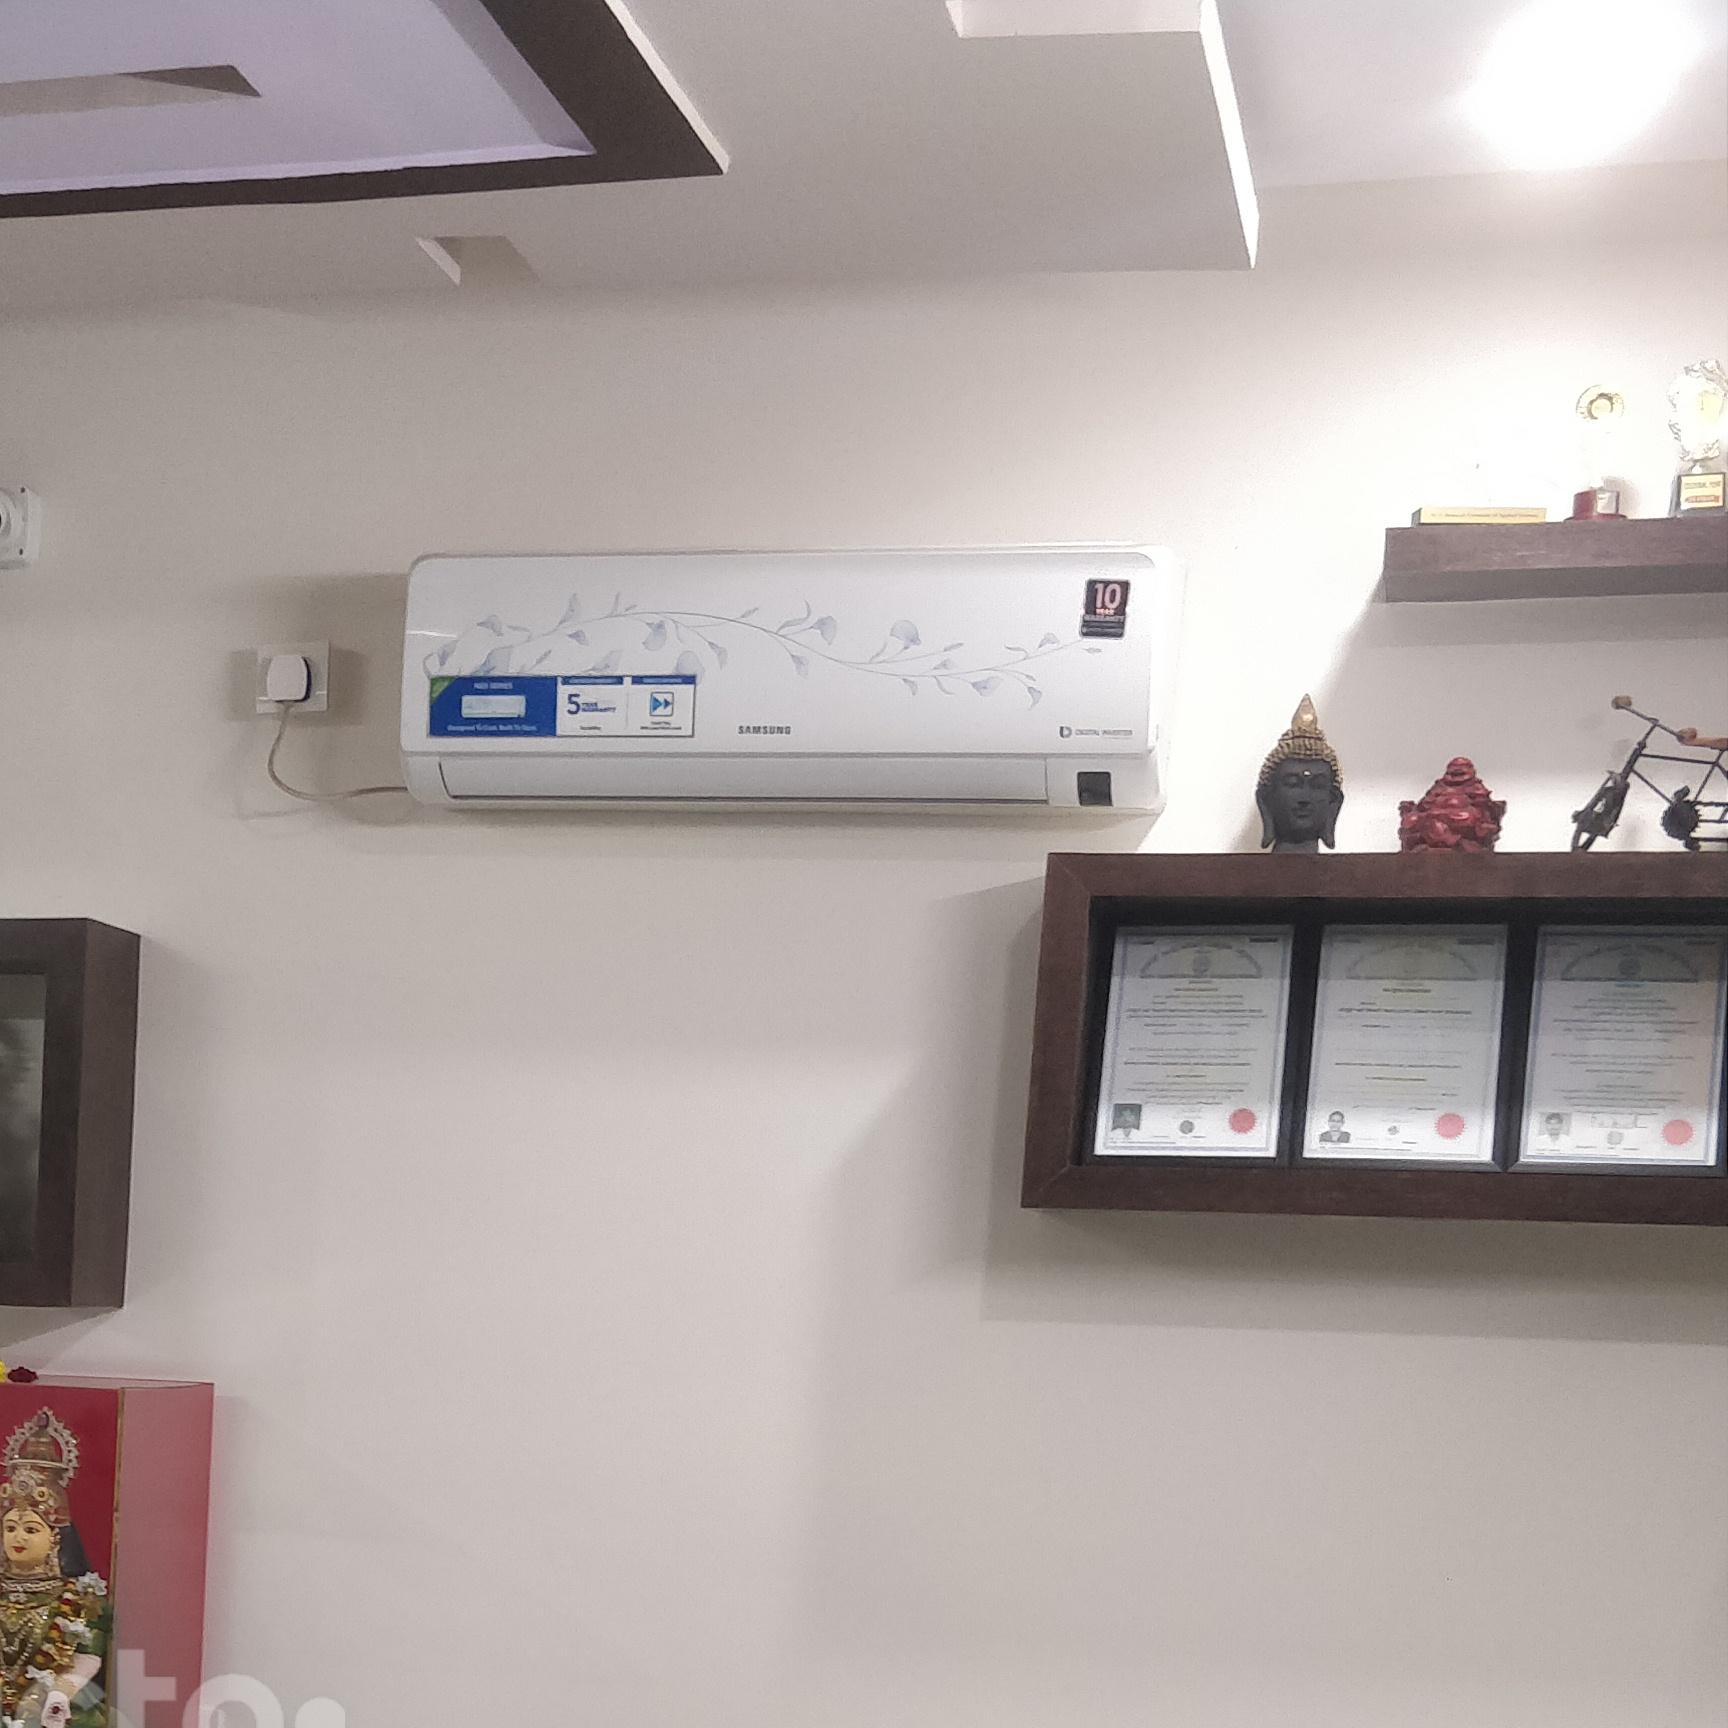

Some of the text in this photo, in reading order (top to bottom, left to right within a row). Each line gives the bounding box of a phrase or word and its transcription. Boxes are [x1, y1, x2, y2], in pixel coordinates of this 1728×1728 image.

[1094, 583, 1121, 609] 10
[567, 693, 581, 715] 5
[737, 725, 791, 735] SAMSUNG
